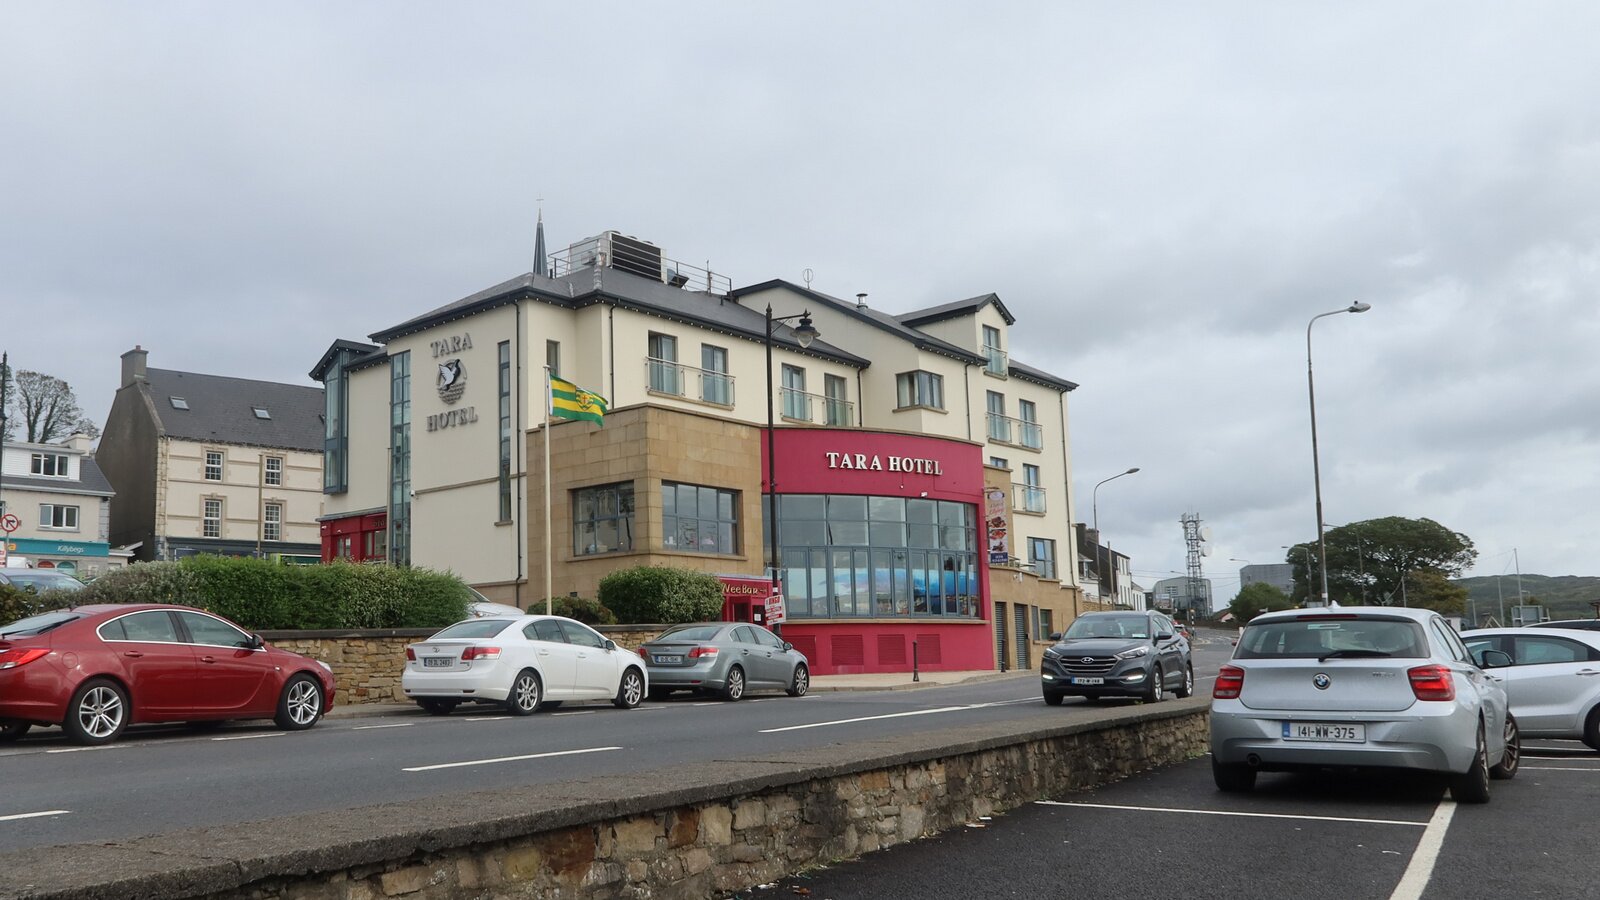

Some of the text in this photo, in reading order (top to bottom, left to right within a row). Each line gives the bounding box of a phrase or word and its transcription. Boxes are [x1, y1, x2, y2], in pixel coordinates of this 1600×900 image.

[430, 332, 473, 358] TARA
[426, 406, 479, 432] HOTEL
[826, 452, 943, 476] TARA HOTEL
[57, 545, 85, 553] Killybegs
[1298, 726, 1355, 739] 141-WW-375
